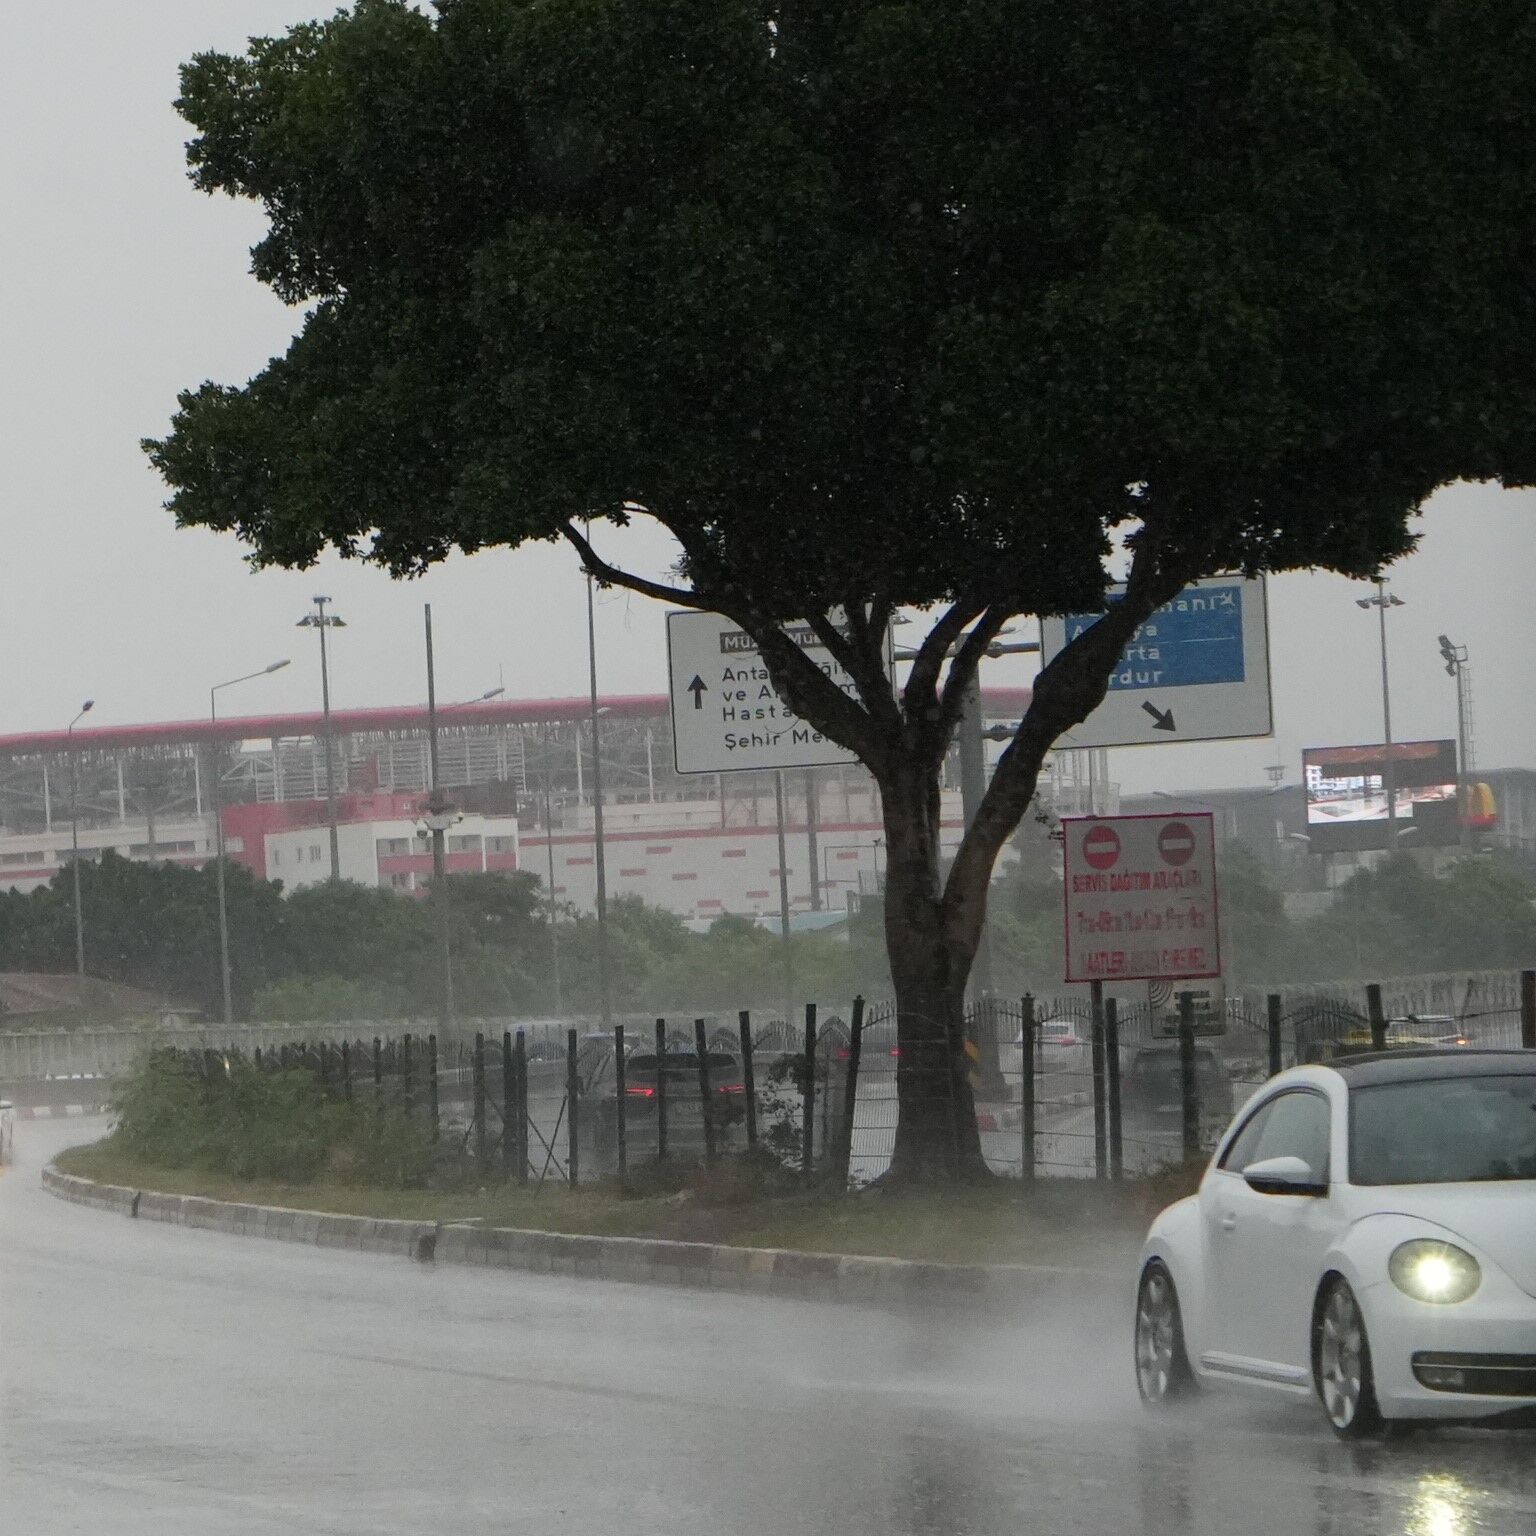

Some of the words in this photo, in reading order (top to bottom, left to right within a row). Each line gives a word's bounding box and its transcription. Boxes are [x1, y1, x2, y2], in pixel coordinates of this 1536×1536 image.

[722, 667, 769, 682] Anta
[723, 690, 746, 701] ve
[725, 733, 781, 750] Şehir
